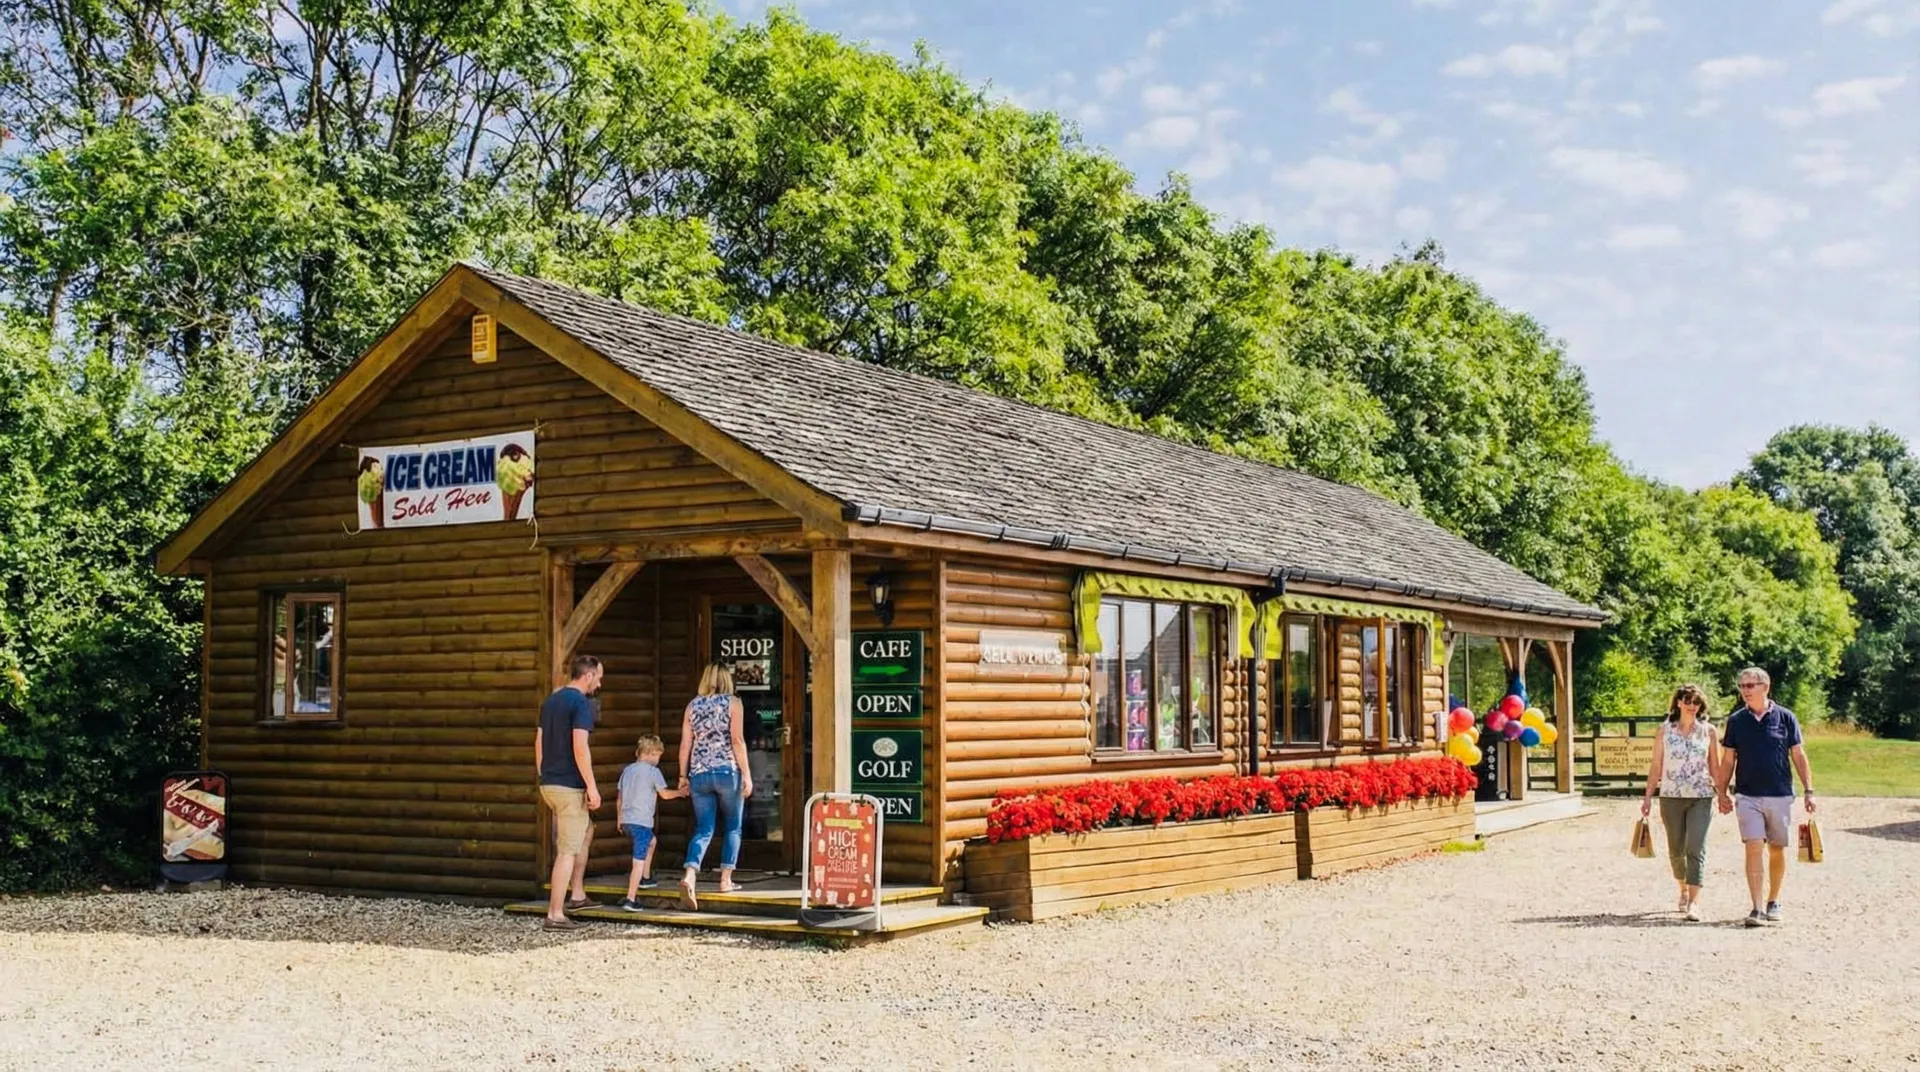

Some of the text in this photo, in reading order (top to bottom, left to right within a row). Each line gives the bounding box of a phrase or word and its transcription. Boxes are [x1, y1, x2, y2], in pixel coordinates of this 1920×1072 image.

[385, 445, 497, 492] ICE CREAM
[392, 488, 492, 521] Sold Hen
[720, 638, 775, 657] SHOP
[860, 639, 912, 658] CAFE
[856, 694, 913, 713] OPEN
[858, 760, 913, 778] GOLF
[879, 797, 913, 815] PEN
